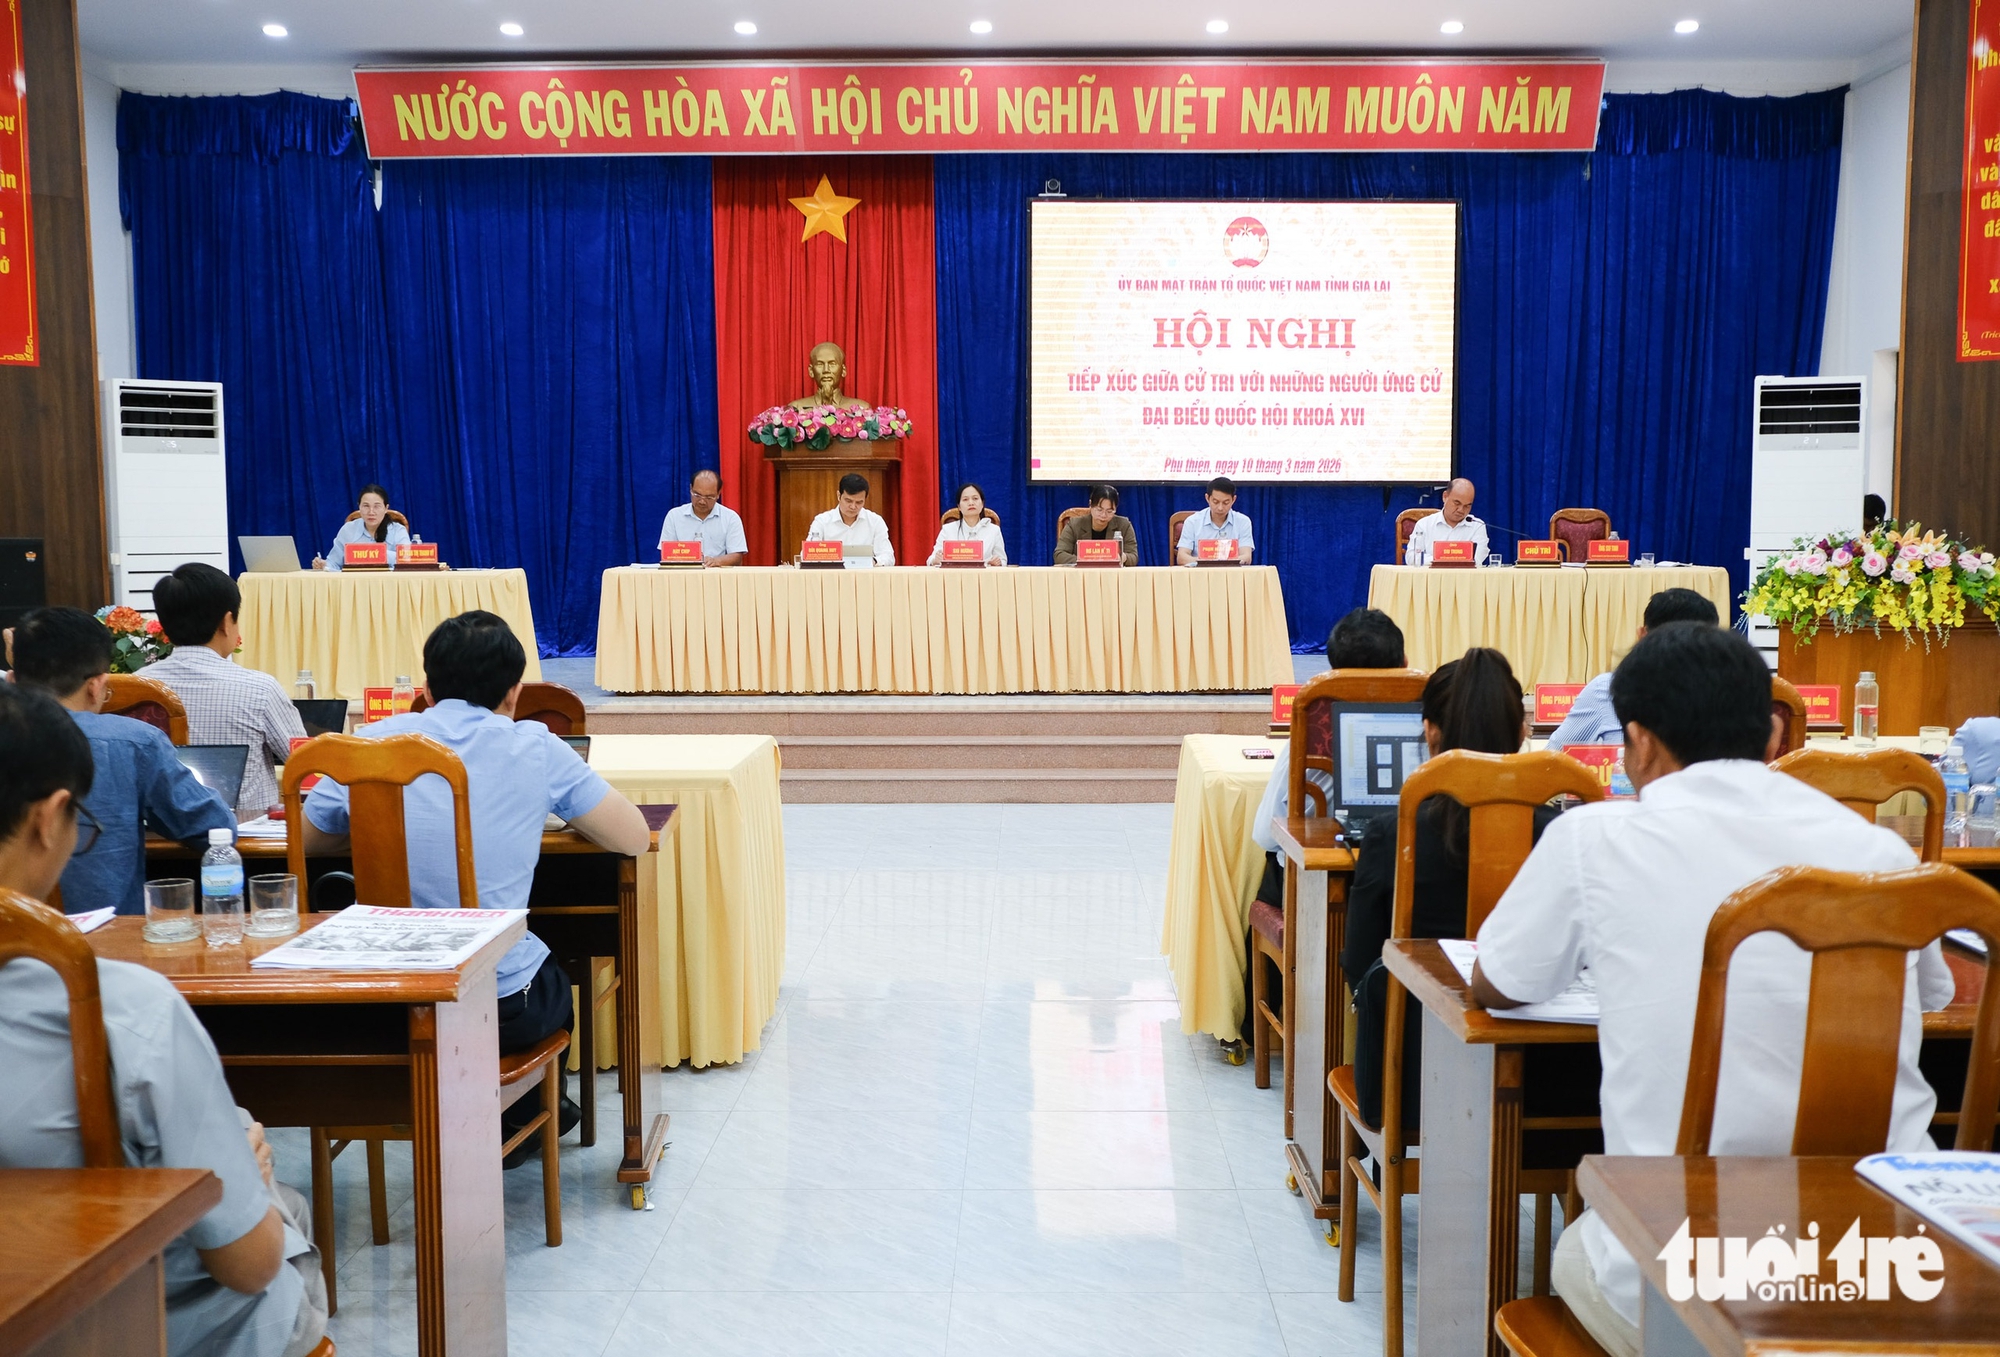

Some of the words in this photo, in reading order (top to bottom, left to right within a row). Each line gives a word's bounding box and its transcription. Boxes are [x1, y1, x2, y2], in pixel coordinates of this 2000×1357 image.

[393, 79, 507, 141] NƯỚC
[519, 78, 632, 148] CỘNG
[643, 76, 730, 138] HÒA
[743, 76, 798, 137] XÃ
[811, 74, 883, 145] HỘI
[897, 68, 979, 136] CHỦ
[996, 74, 1120, 135] NGHĨA
[1133, 73, 1227, 144] VIỆT
[1241, 86, 1331, 135] NAM
[1344, 77, 1466, 134] MUÔN
[1478, 76, 1572, 134] NĂM
[1136, 280, 1159, 291] BAN
[1296, 280, 1321, 292] NAM
[1353, 280, 1371, 292] GIA
[1374, 280, 1391, 292] LAI
[1153, 309, 1232, 356] HỘI
[1246, 317, 1356, 356] NGHỊ
[1067, 367, 1101, 391] TIẾP
[1106, 369, 1137, 391] XÚC
[1143, 370, 1179, 391] GIỮA
[1185, 367, 1207, 392] CỬ
[1211, 374, 1235, 392] TRI
[1240, 370, 1265, 392] VỚI
[1270, 370, 1325, 392] NHỮNG
[1330, 369, 1378, 392] NGƯỜI
[1383, 370, 1415, 392] ỨNG
[1421, 367, 1443, 393] CỬ
[1143, 407, 1169, 429] ĐẠI
[1174, 399, 1209, 425] BIỂU
[1215, 401, 1257, 427] QUỐC
[1262, 403, 1288, 430] HỘI
[1293, 403, 1335, 426] KHOÁ
[1340, 407, 1365, 426] XVI
[1242, 458, 1254, 473] 10
[1285, 458, 1292, 473] 3
[1317, 458, 1342, 473] 2026
[352, 549, 368, 559] THƯ
[369, 549, 380, 559] KÝ
[1524, 545, 1539, 555] CHỦ
[1540, 546, 1551, 555] TRÌ
